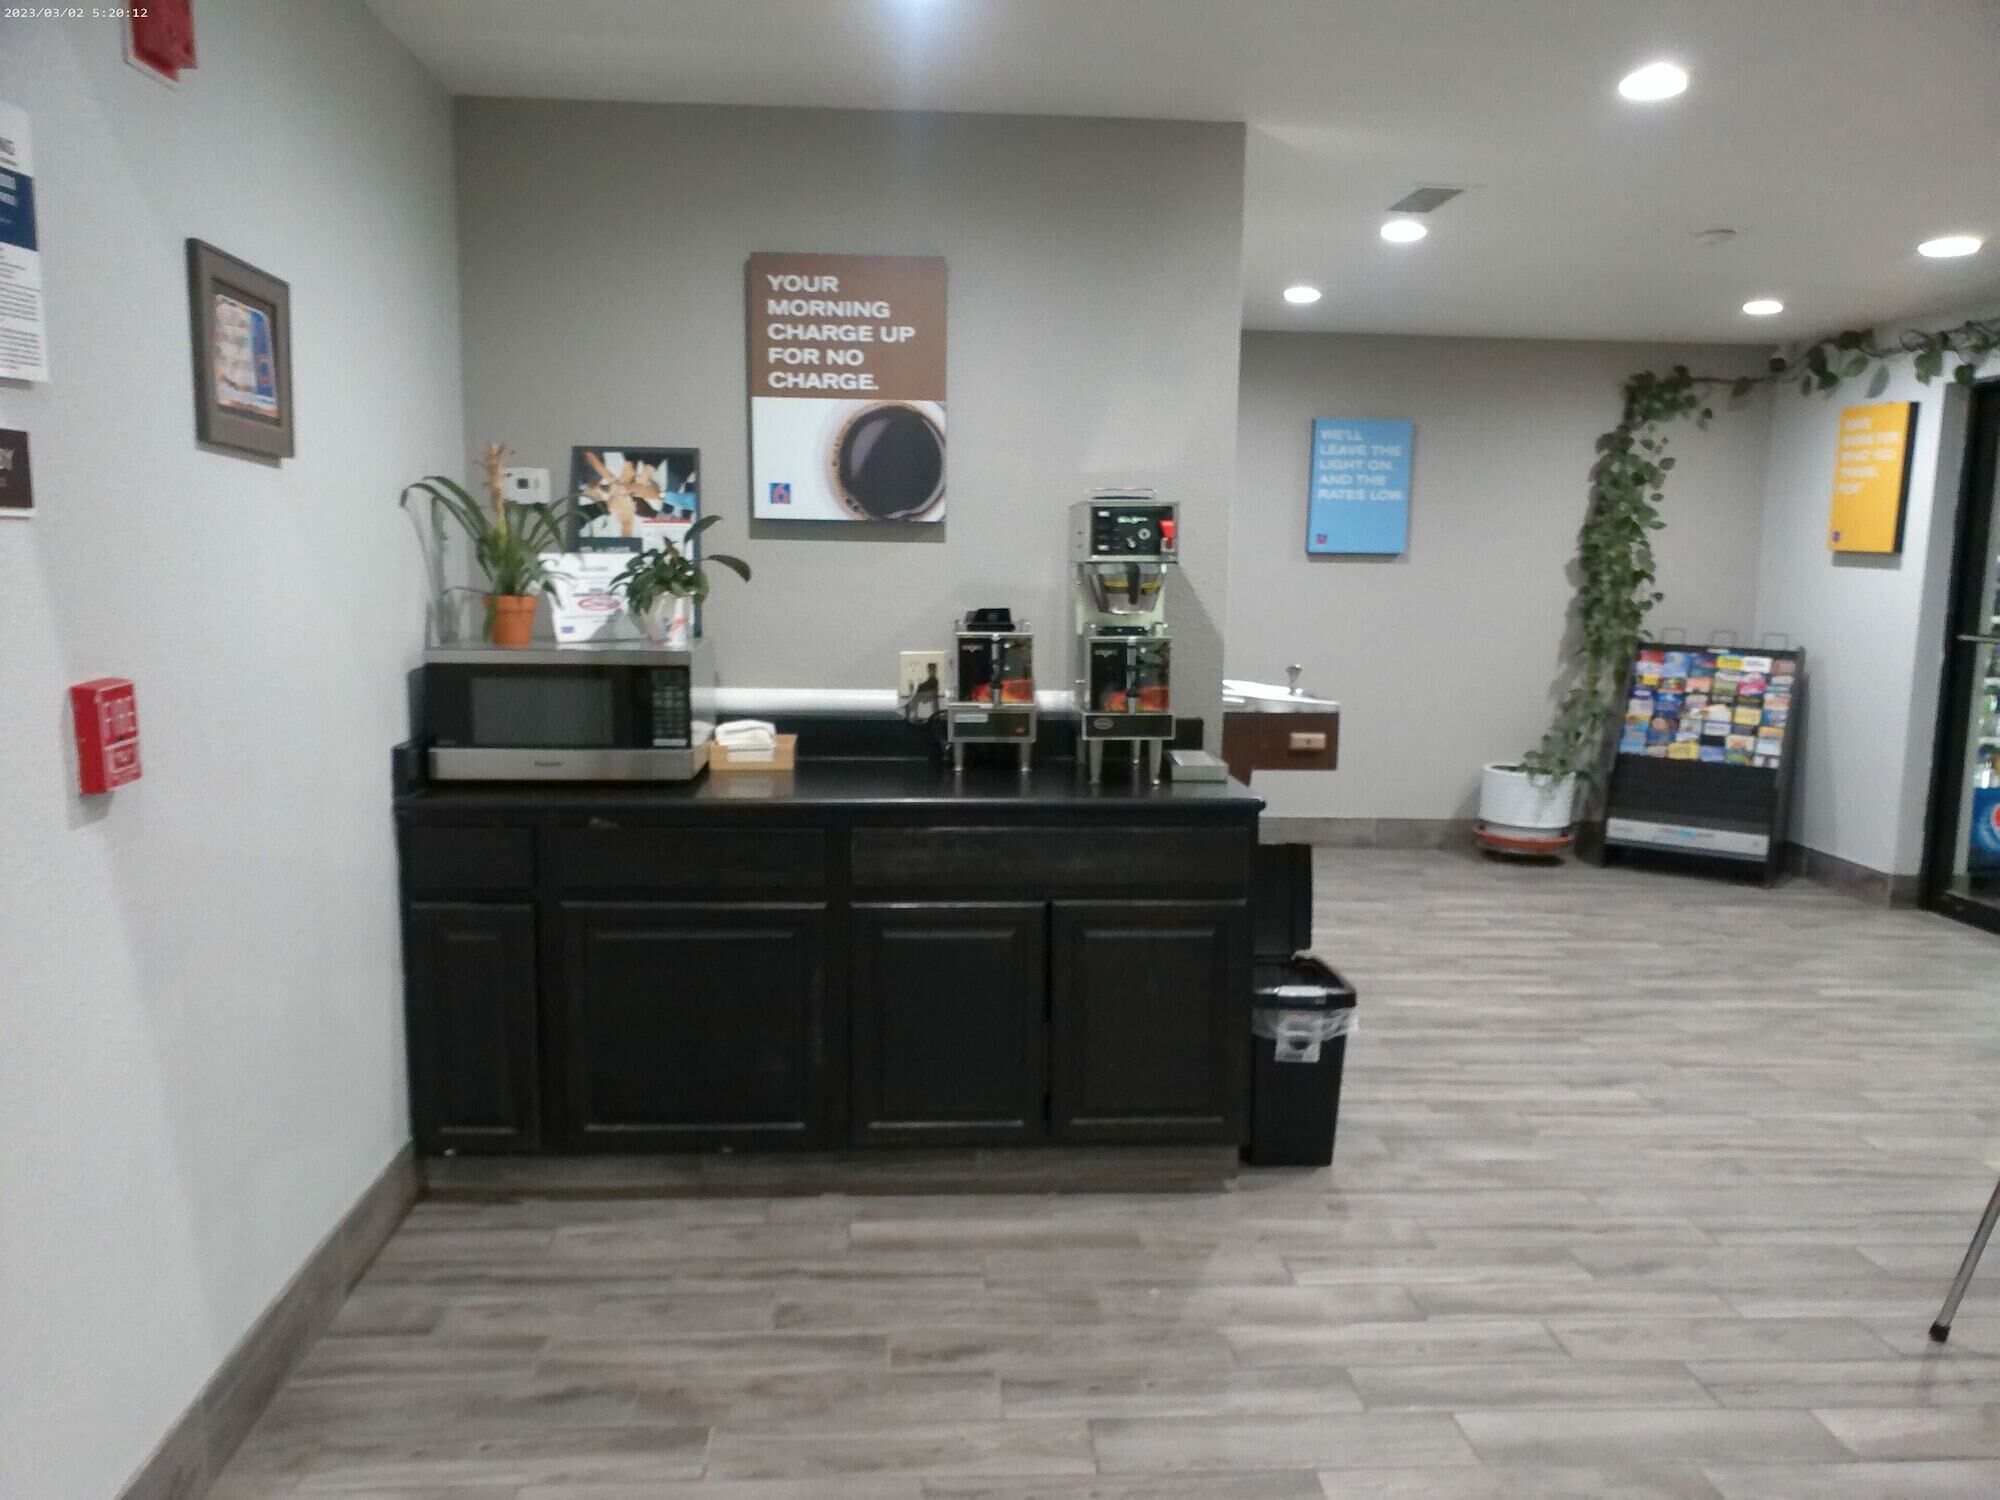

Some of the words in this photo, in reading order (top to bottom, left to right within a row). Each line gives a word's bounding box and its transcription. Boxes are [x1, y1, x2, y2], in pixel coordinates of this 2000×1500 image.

[767, 274, 839, 293] YOUR
[767, 300, 891, 318] MORNING
[767, 323, 874, 342] CHARGE
[880, 326, 916, 343] UP
[768, 347, 820, 365] FOR
[826, 349, 864, 366] NO
[768, 372, 879, 390] CHARGE.
[1319, 445, 1368, 456] LEAVE
[1370, 445, 1402, 457] THE
[1318, 460, 1364, 471] LIGHT
[1367, 460, 1394, 471] ON
[1318, 475, 1352, 485] AND
[1356, 475, 1386, 486] THE
[1317, 489, 1366, 500] RATES
